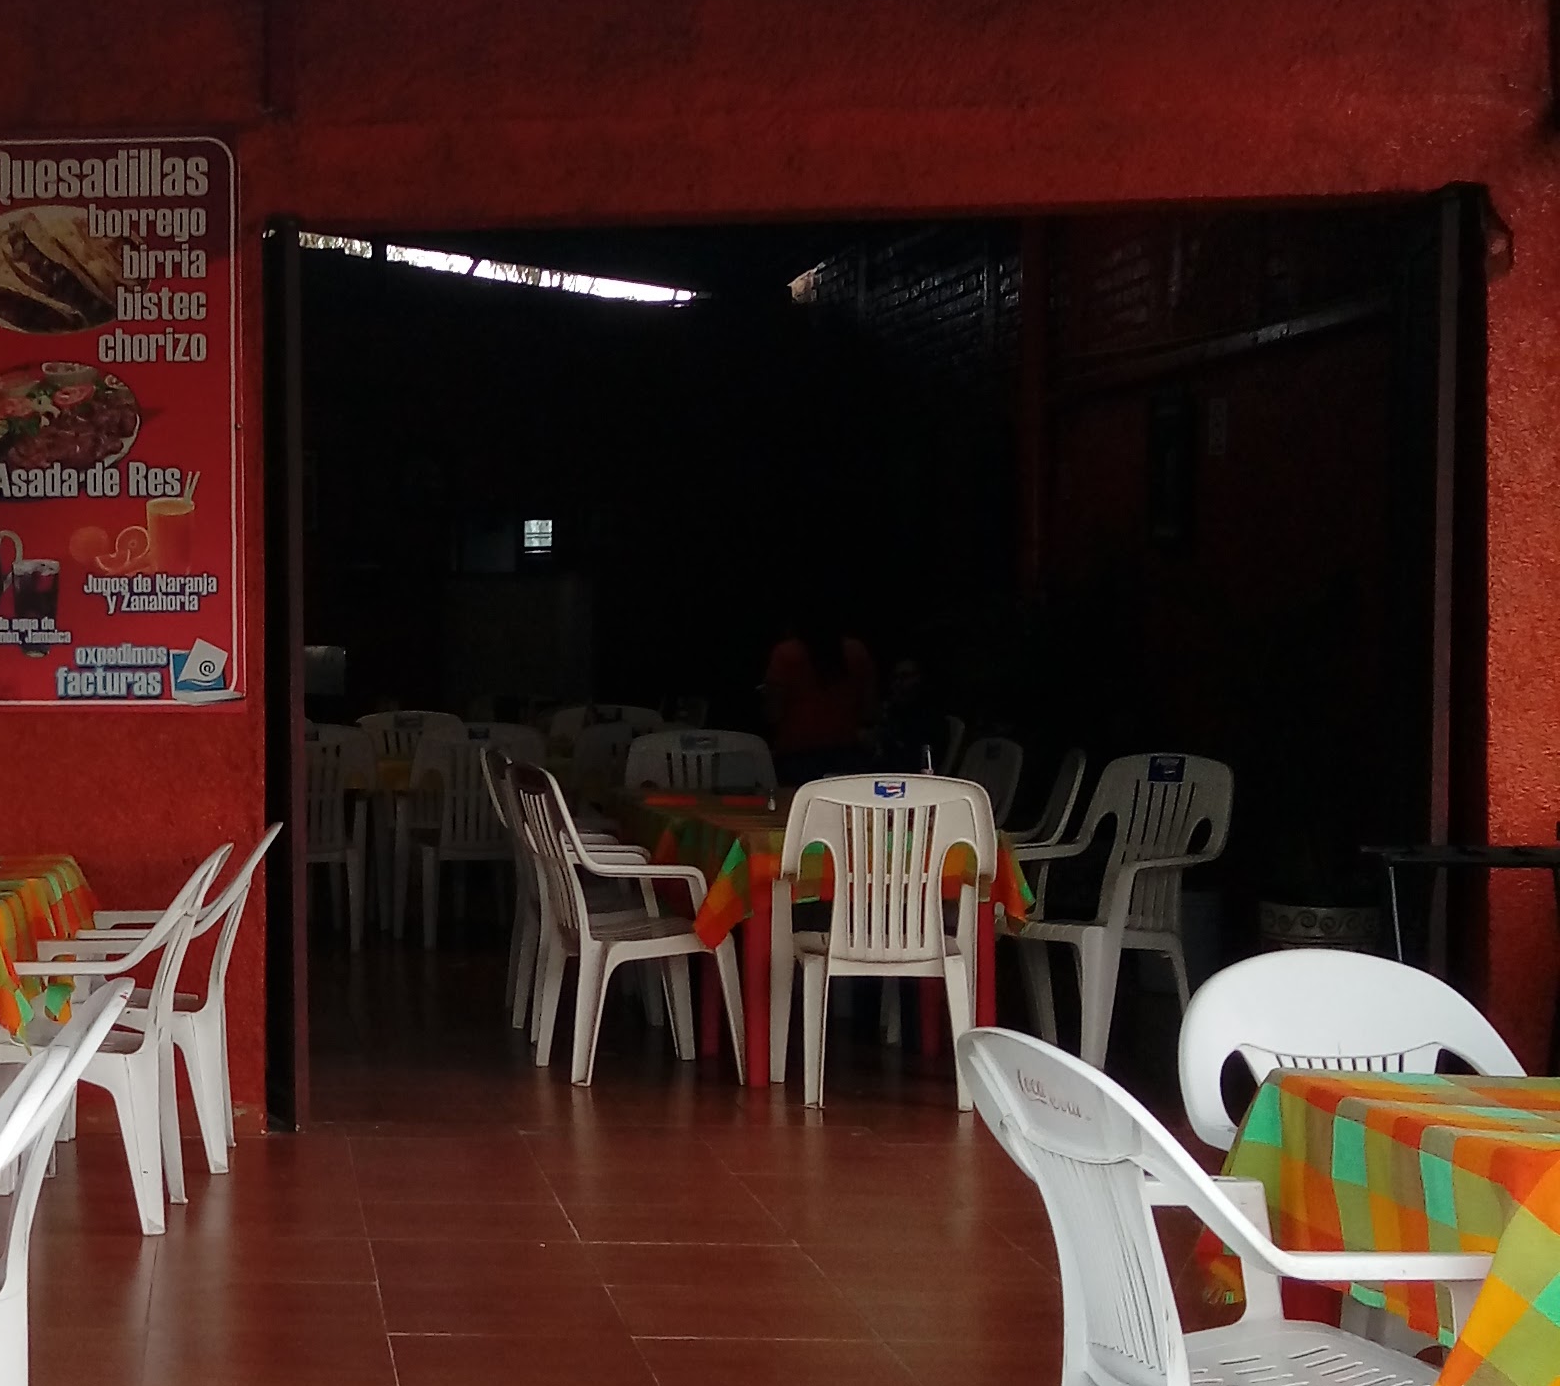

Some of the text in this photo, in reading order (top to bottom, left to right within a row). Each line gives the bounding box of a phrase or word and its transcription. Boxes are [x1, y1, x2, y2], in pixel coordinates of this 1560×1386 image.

[88, 204, 206, 242] borrego
[123, 244, 206, 279] birria
[116, 286, 206, 321] bistec
[98, 327, 207, 362] chorizo
[87, 465, 120, 497] de
[129, 462, 182, 496] Res
[84, 573, 217, 597] Jugos de Naranja
[107, 592, 199, 614] y Zanahoria
[25, 629, 71, 644] Jamaica
[75, 645, 168, 667] expedimos
[56, 667, 162, 697] facturas
